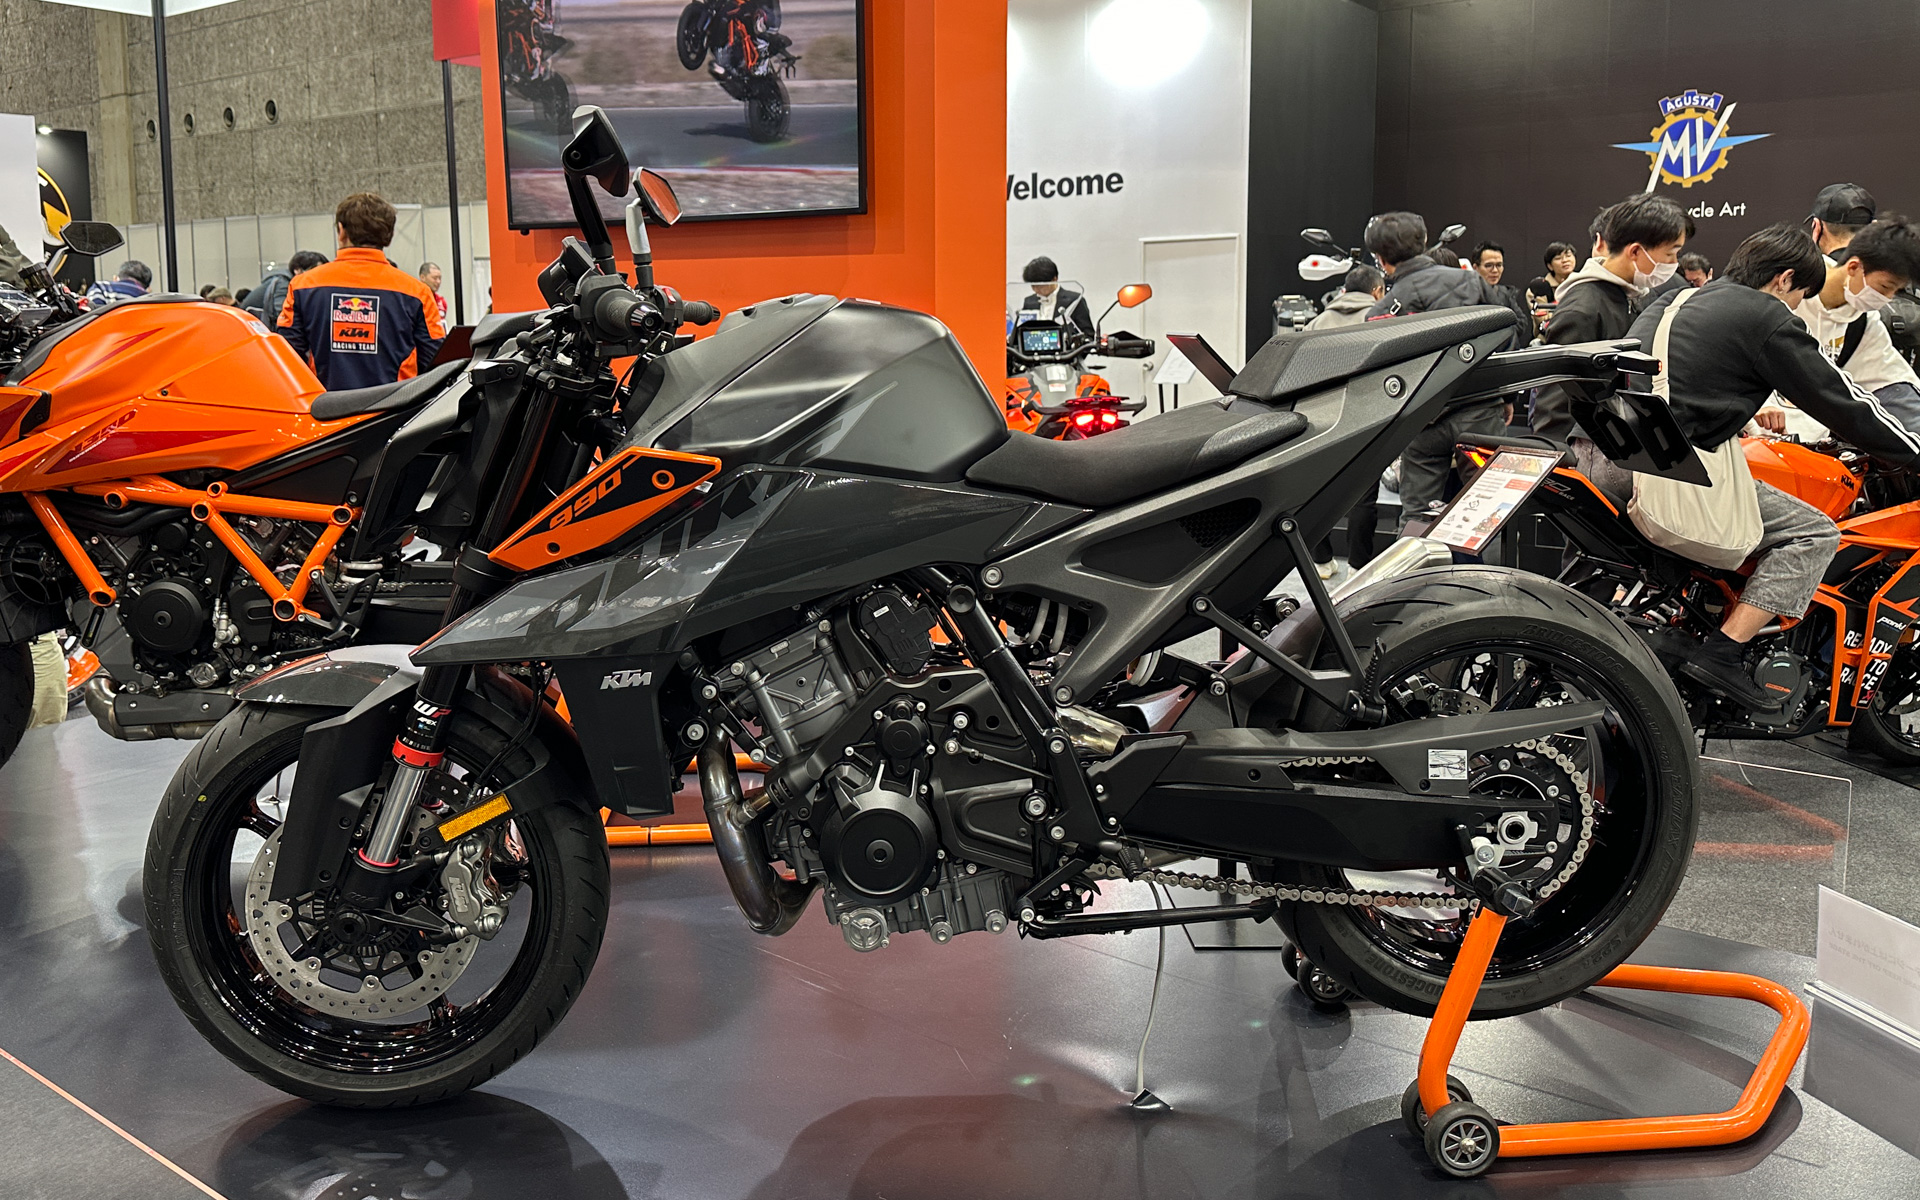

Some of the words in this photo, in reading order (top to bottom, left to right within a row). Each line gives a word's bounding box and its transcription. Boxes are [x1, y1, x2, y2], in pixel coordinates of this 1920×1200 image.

[1666, 95, 1715, 112] AGUSTA
[1645, 102, 1738, 193] MV
[1006, 172, 1124, 201] elcome
[1719, 201, 1746, 217] Art
[333, 309, 354, 322] Red
[354, 310, 376, 324] Bull
[338, 327, 370, 338] KTM
[332, 342, 357, 350] RACING
[358, 343, 375, 351] TEAM
[1840, 473, 1855, 491] KTM
[549, 468, 622, 530] 990
[1519, 623, 1625, 674] BRIDGESTONE
[1869, 659, 1888, 676] TO
[600, 669, 652, 690] KTM
[413, 700, 452, 718] WP
[448, 876, 468, 913] KTM
[1364, 953, 1444, 997] IDGESTONE
